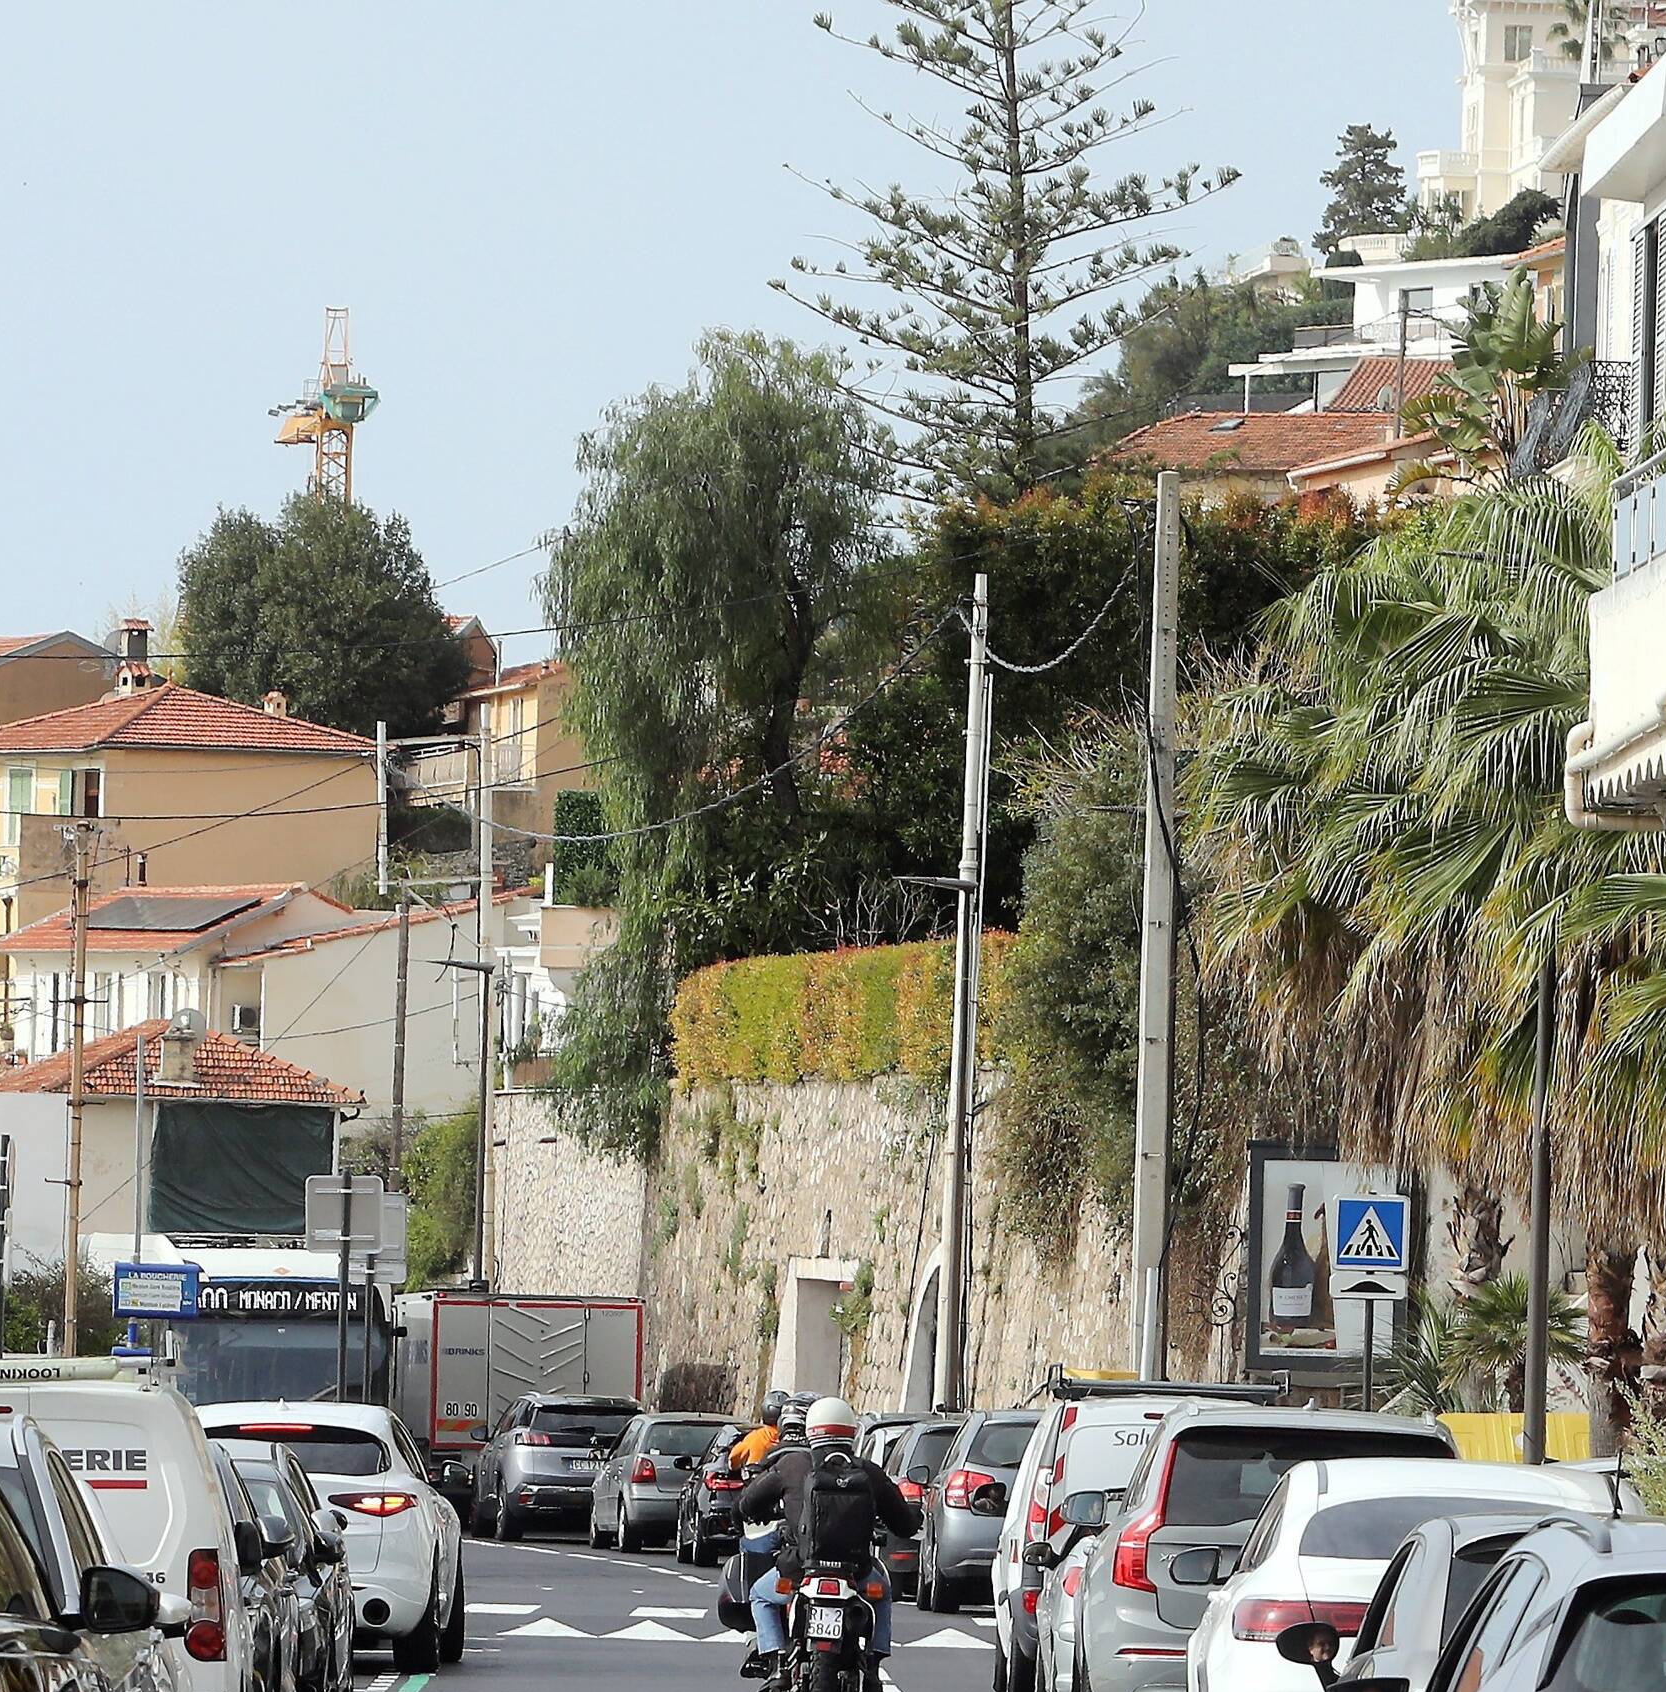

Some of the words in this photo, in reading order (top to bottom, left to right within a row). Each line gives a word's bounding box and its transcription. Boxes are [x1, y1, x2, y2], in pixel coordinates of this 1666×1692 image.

[305, 1291, 357, 1310] MENTN
[445, 1402, 459, 1417] 80
[464, 1403, 478, 1417] 90
[835, 1609, 843, 1623] 2
[808, 1622, 841, 1637] 5840
